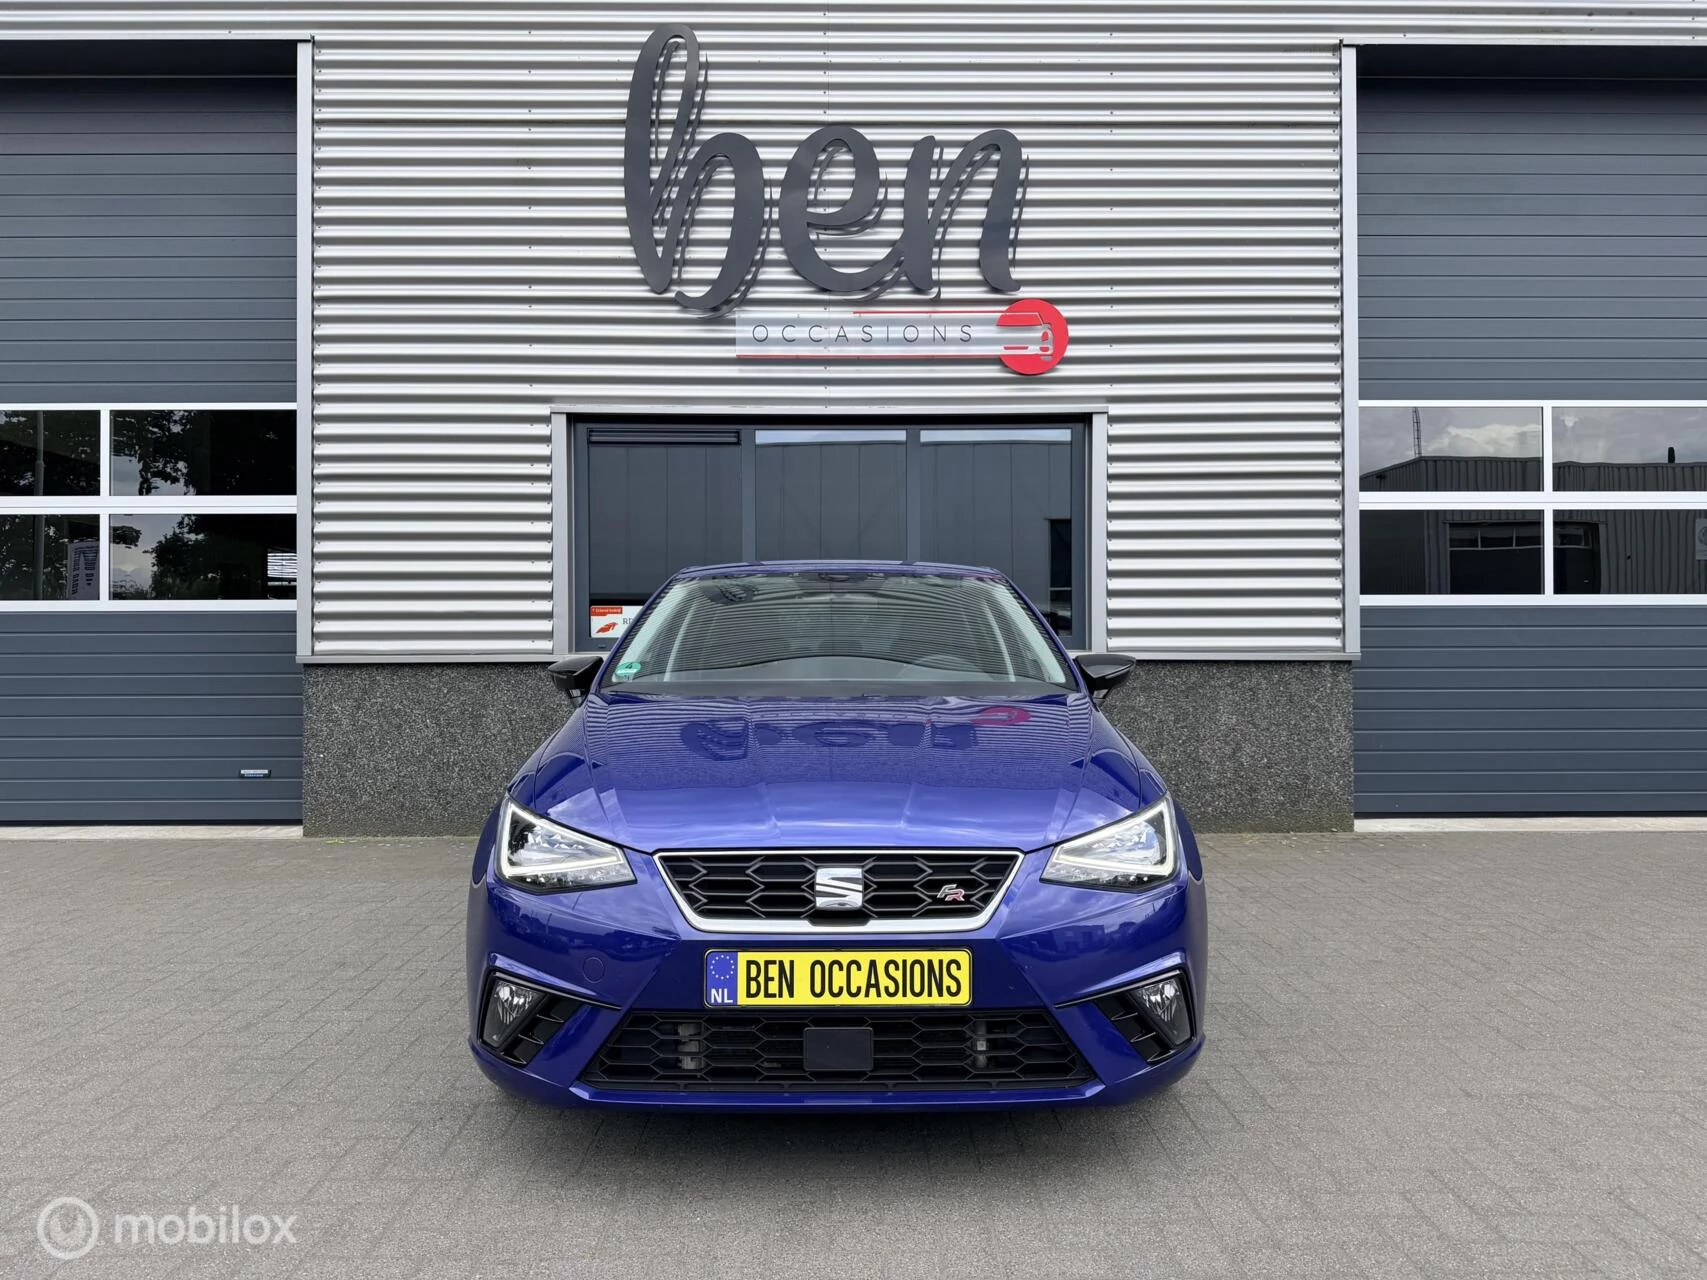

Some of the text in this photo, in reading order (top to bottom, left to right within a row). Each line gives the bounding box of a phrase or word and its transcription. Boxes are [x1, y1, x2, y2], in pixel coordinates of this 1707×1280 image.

[752, 323, 974, 343] OCCASIONS
[936, 883, 965, 901] FR
[745, 958, 961, 998] BEN OCCASIONS
[710, 988, 733, 1003] NL
